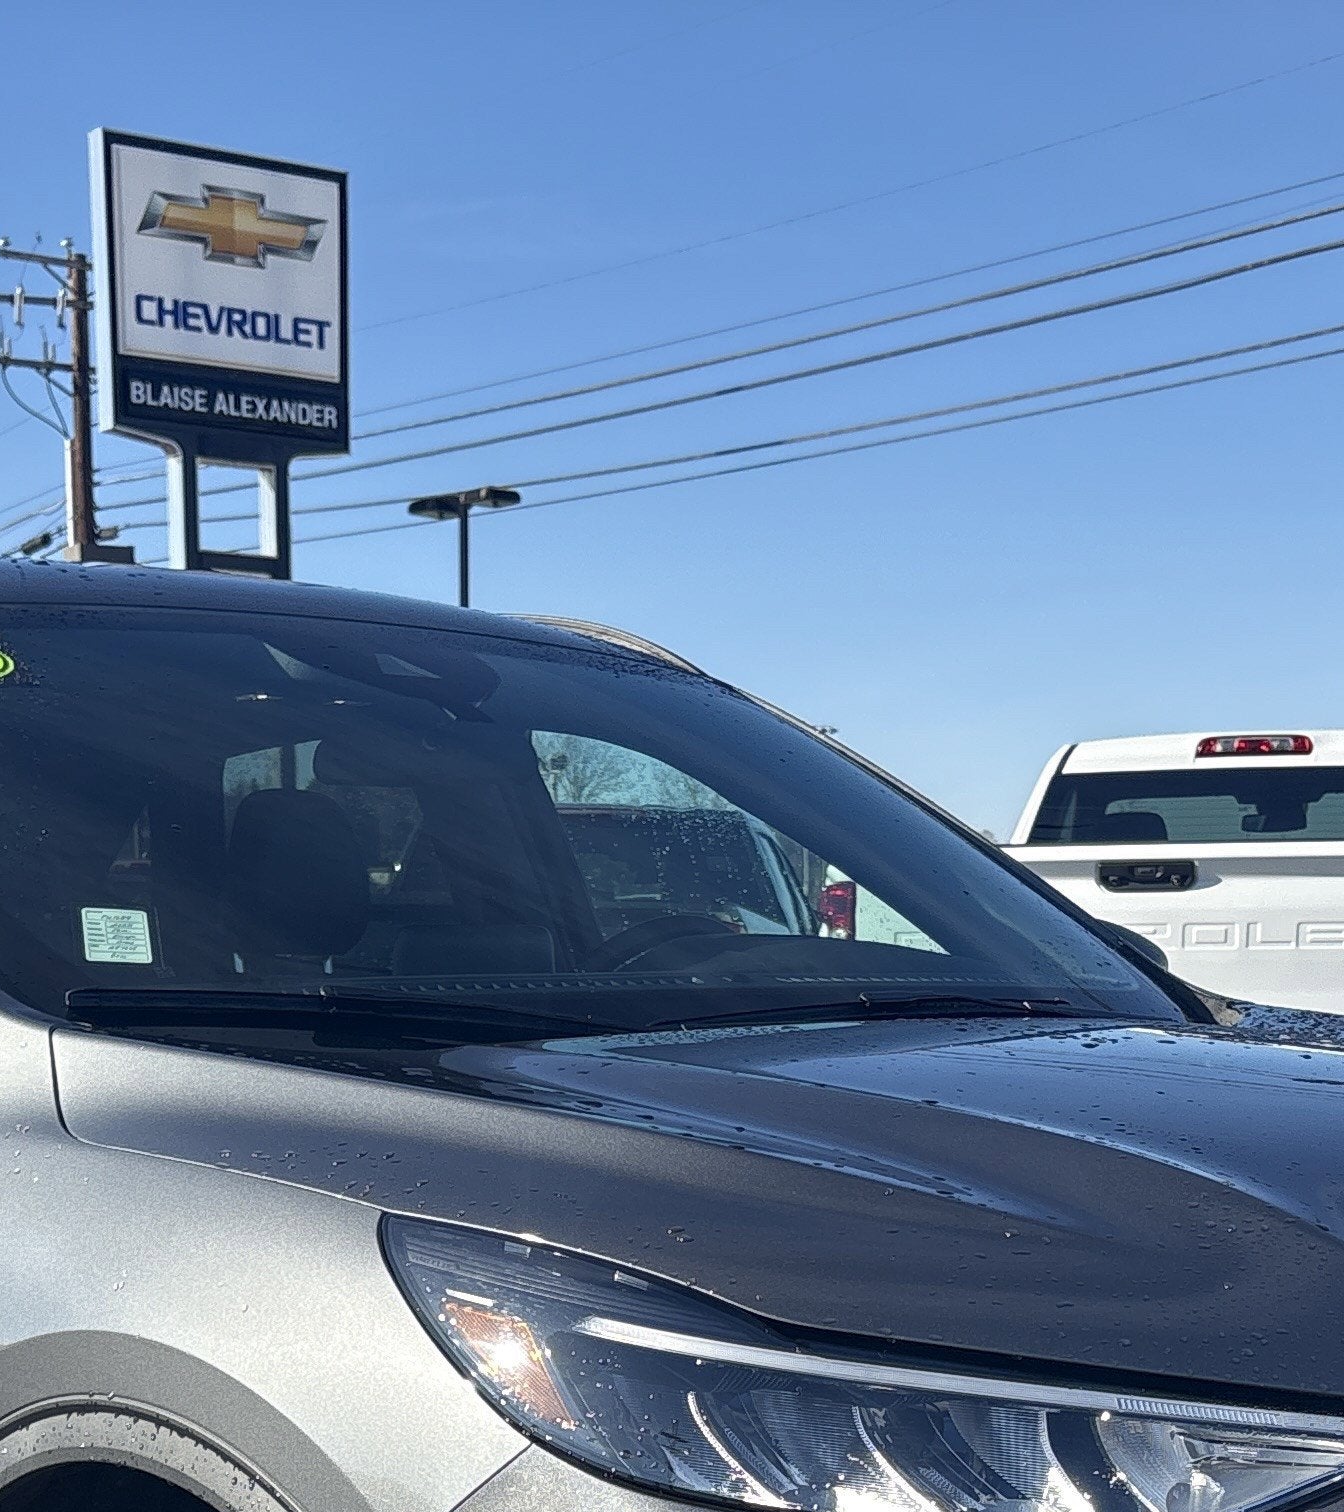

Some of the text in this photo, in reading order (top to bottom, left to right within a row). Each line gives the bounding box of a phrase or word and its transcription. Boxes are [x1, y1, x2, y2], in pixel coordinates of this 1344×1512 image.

[134, 293, 332, 350] CHEVROLET
[129, 380, 339, 429] BLAISE ALEXANDER
